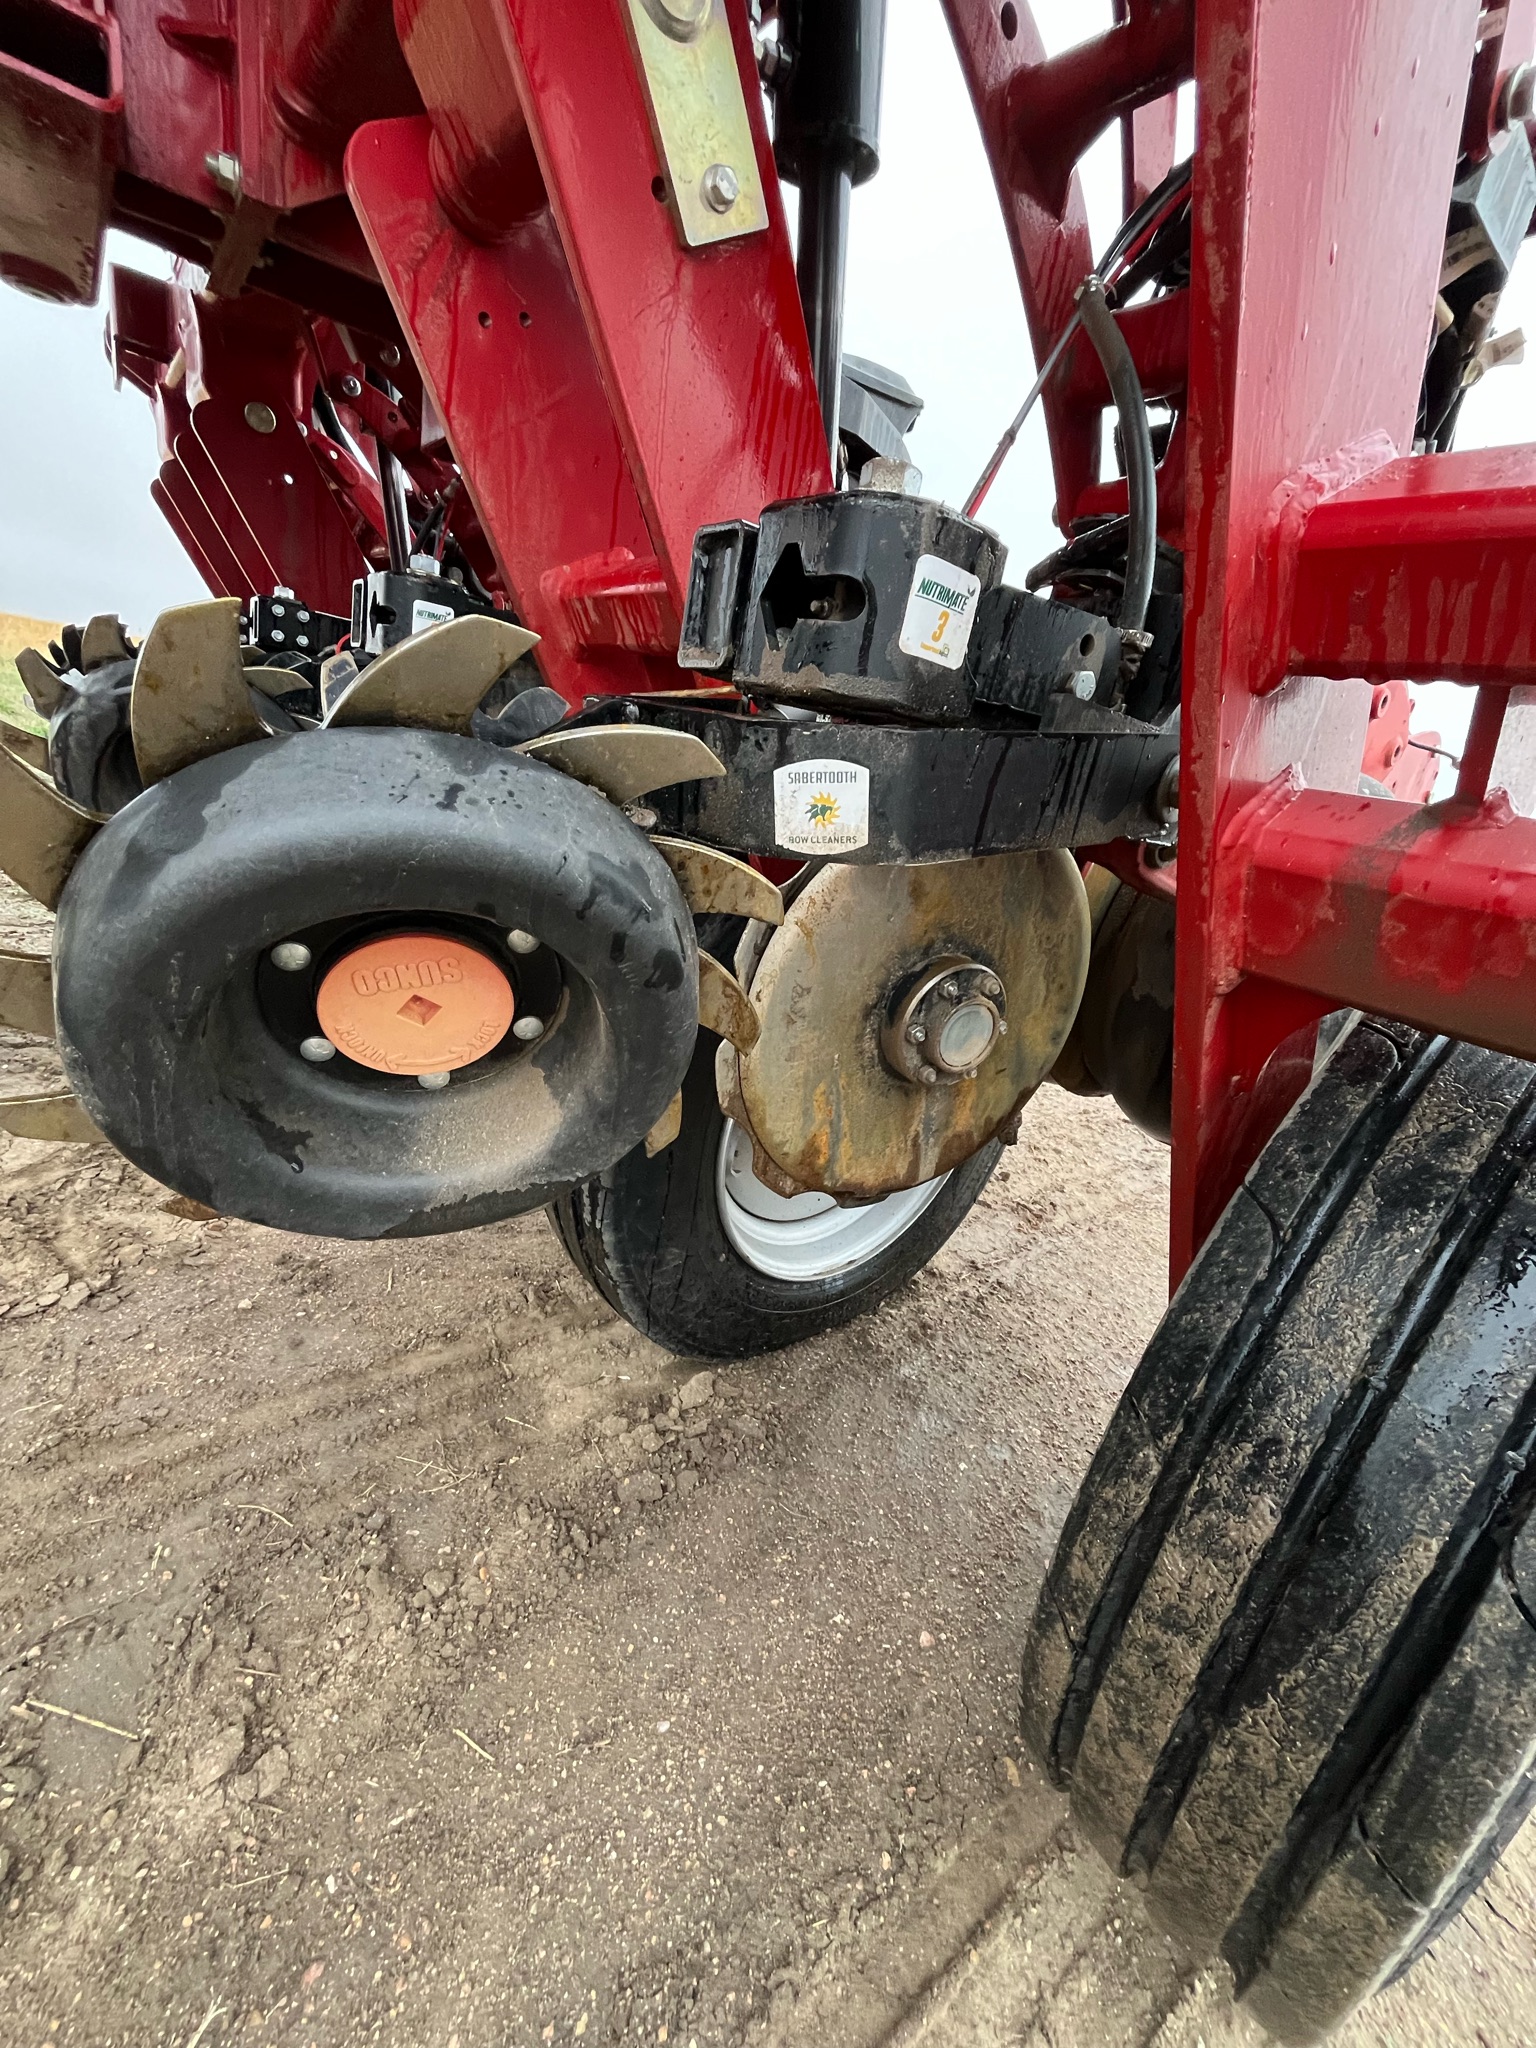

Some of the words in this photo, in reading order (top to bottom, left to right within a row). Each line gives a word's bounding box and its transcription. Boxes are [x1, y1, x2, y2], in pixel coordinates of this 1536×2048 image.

[917, 577, 969, 612] NUTRIMATE
[416, 609, 448, 622] NUTRIMATE
[931, 610, 950, 642] 3
[788, 771, 857, 784] SABERTOOTH
[810, 835, 858, 845] CLEANERS
[351, 957, 464, 997] SUNCO
[334, 1023, 386, 1064] UNLOCK
[468, 1020, 501, 1051] LOCK
